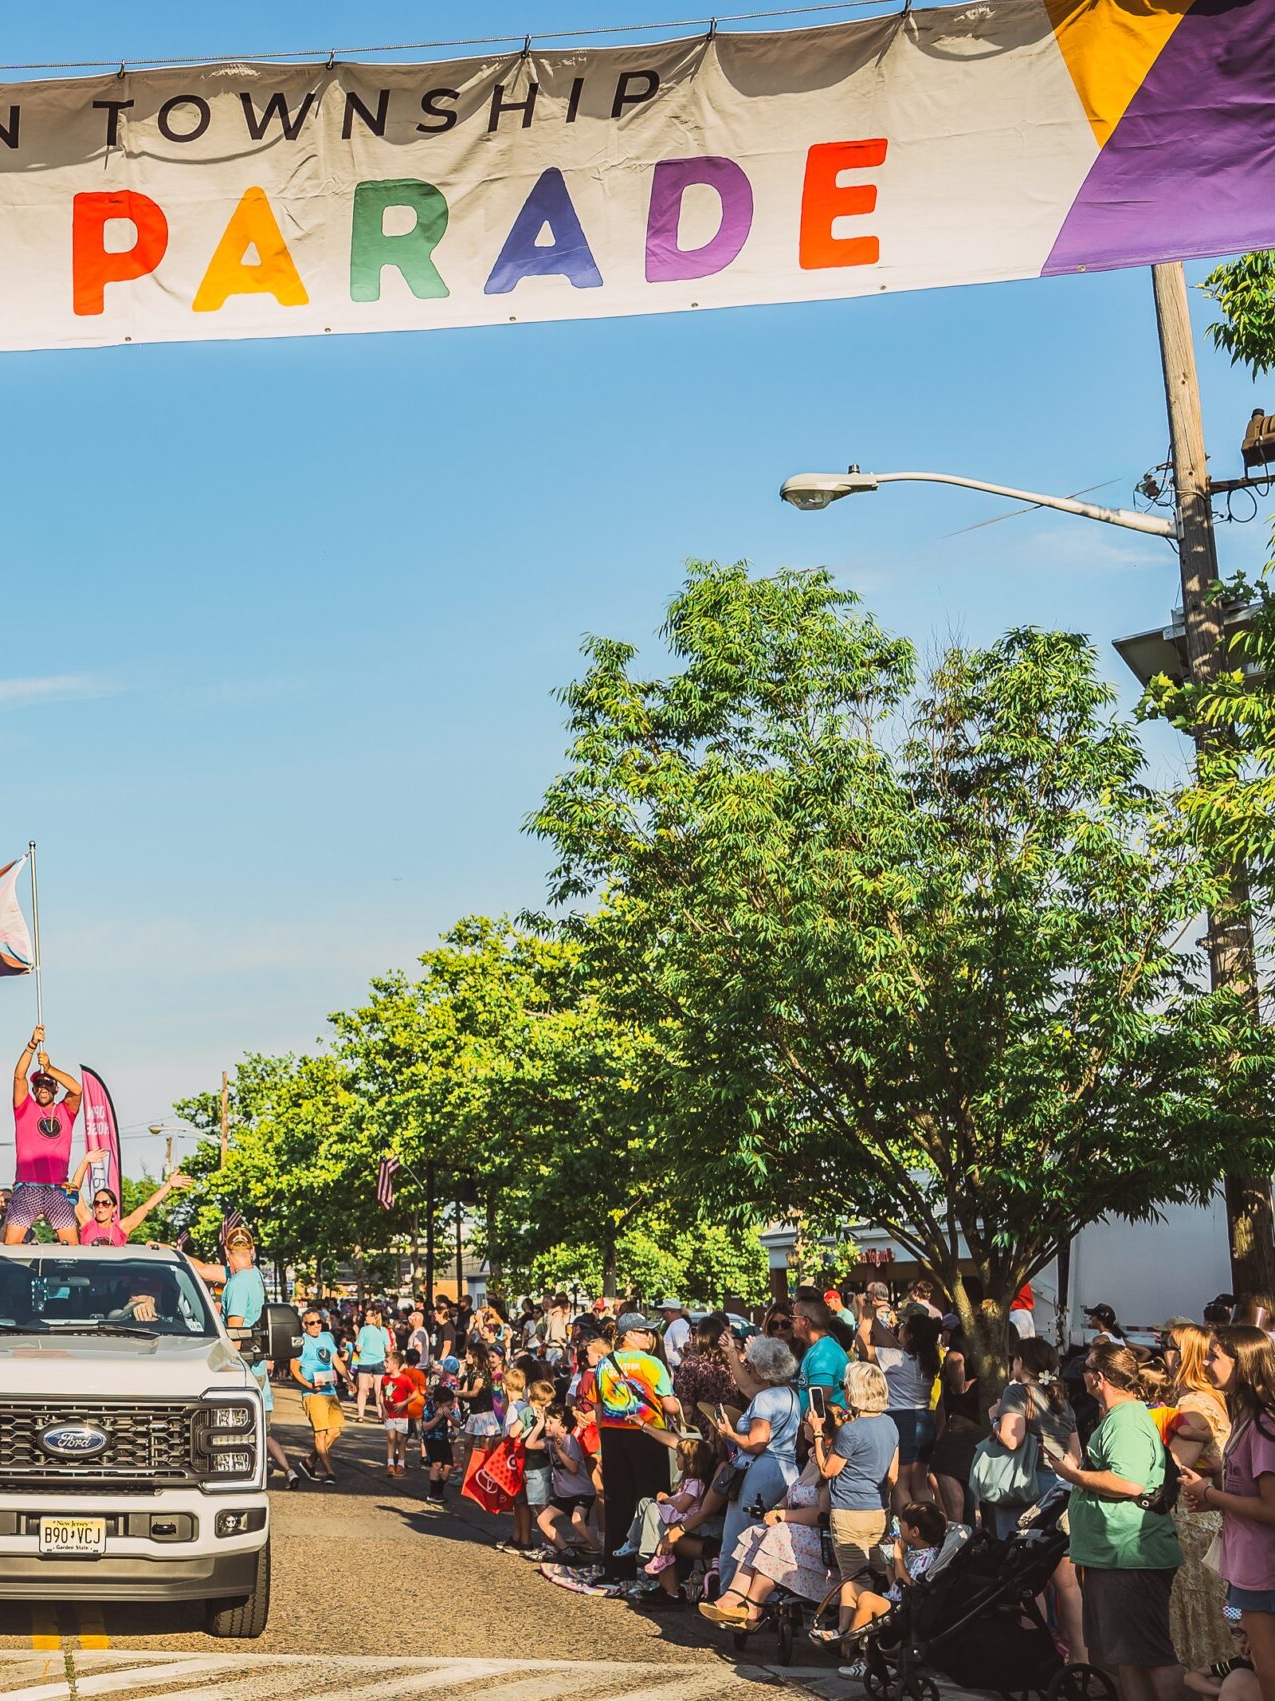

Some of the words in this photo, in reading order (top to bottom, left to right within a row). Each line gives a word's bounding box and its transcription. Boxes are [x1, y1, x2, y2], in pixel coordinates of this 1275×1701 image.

[92, 69, 660, 148] TOWNSHIP
[72, 138, 888, 316] PARADE
[57, 1432, 92, 1448] Ford
[71, 1520, 90, 1528] Jersey
[44, 1526, 69, 1544] B90
[77, 1527, 101, 1544] VCJ
